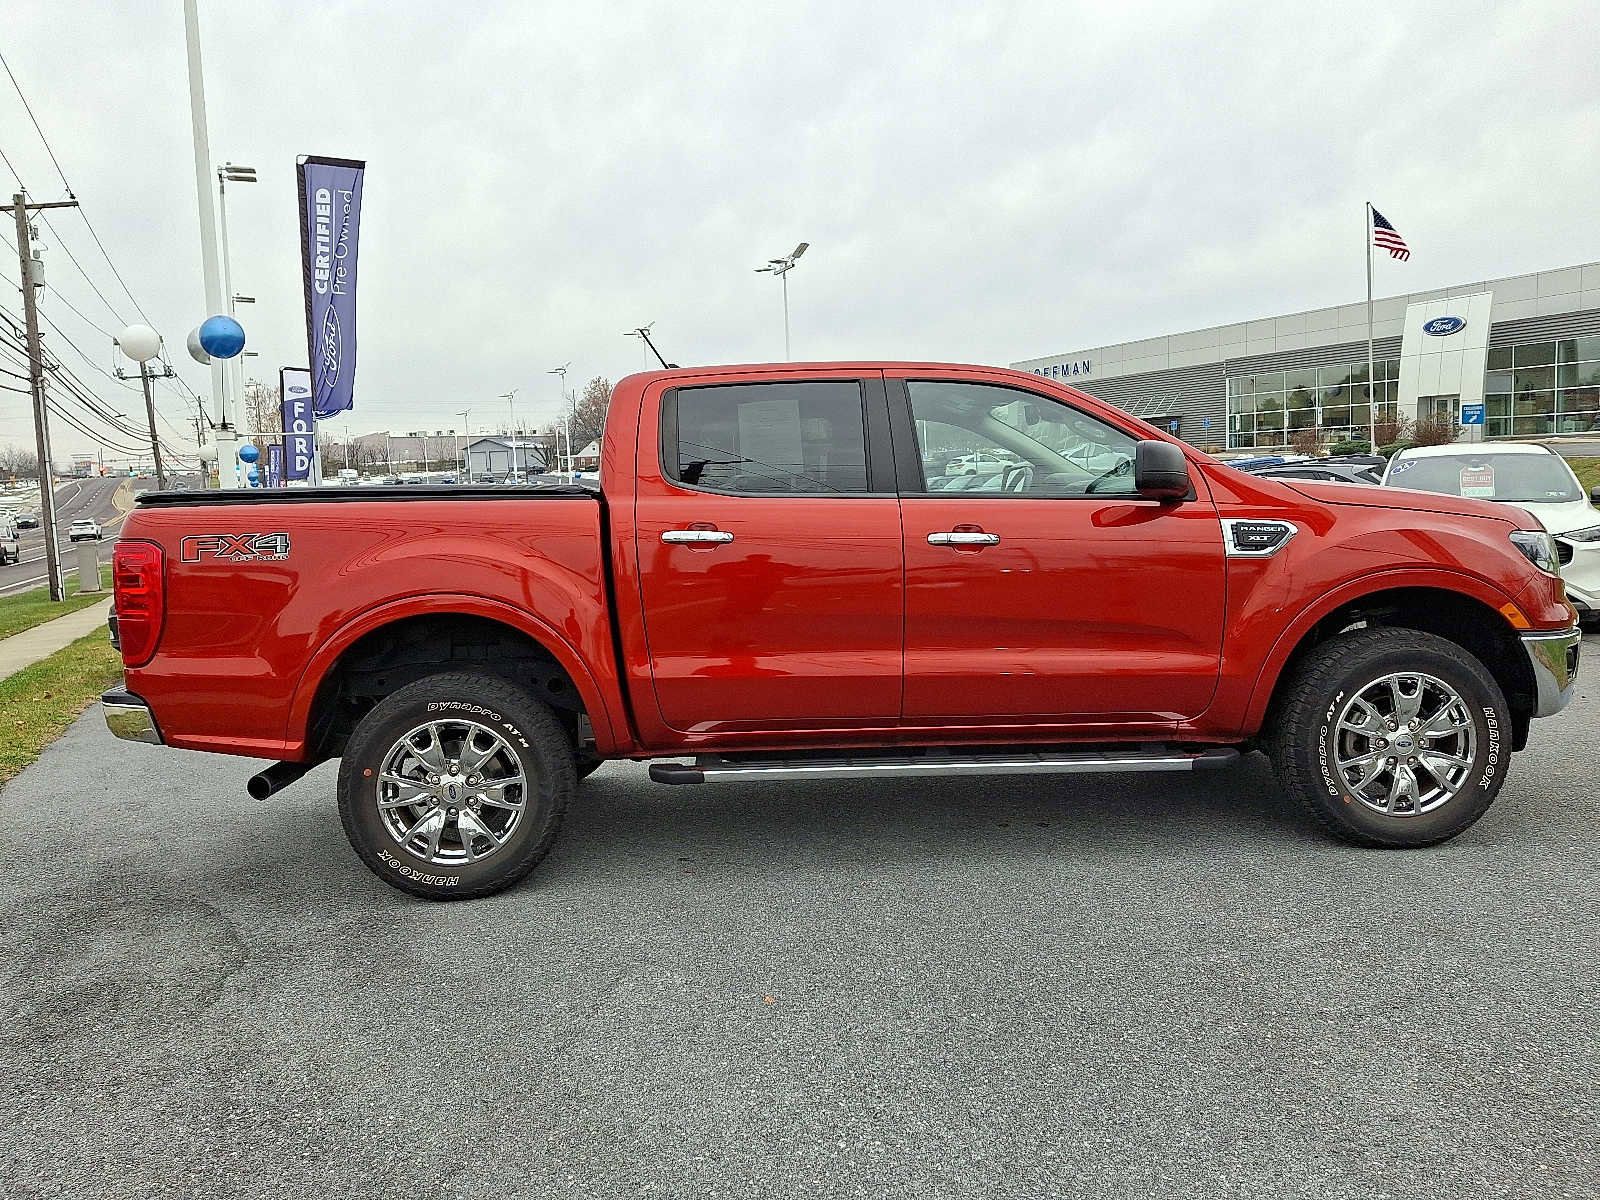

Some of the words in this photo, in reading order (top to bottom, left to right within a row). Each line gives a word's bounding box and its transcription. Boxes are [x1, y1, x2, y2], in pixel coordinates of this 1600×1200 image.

[314, 188, 331, 295] CERTIFIED
[332, 190, 353, 295] Pre-Owned
[322, 321, 338, 371] Ford
[1429, 319, 1455, 332] Ford
[1028, 359, 1091, 378] OFFMAN
[292, 401, 309, 472] FORD
[181, 532, 290, 563] FX4
